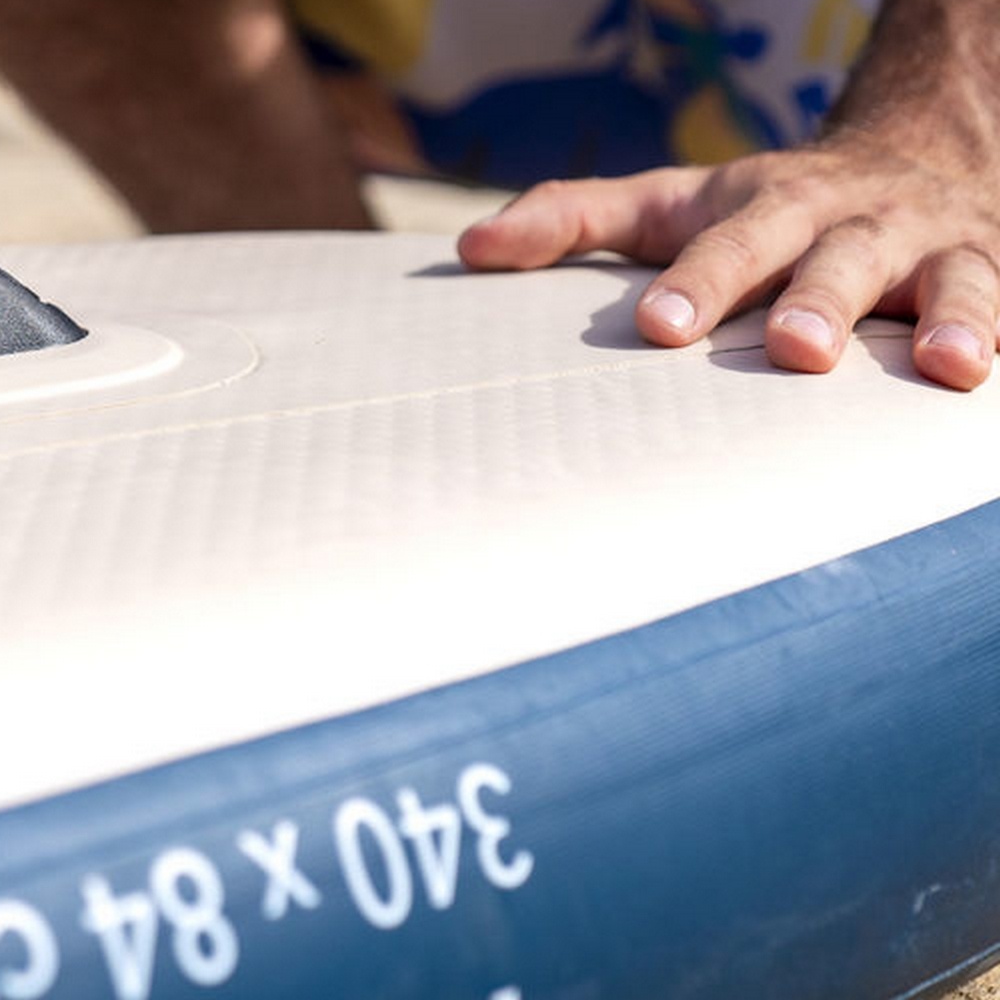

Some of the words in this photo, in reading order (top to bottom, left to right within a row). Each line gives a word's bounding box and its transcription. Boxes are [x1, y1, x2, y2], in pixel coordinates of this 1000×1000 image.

[238, 819, 321, 920] x
[334, 763, 533, 929] 340
[80, 847, 239, 1000] 84
